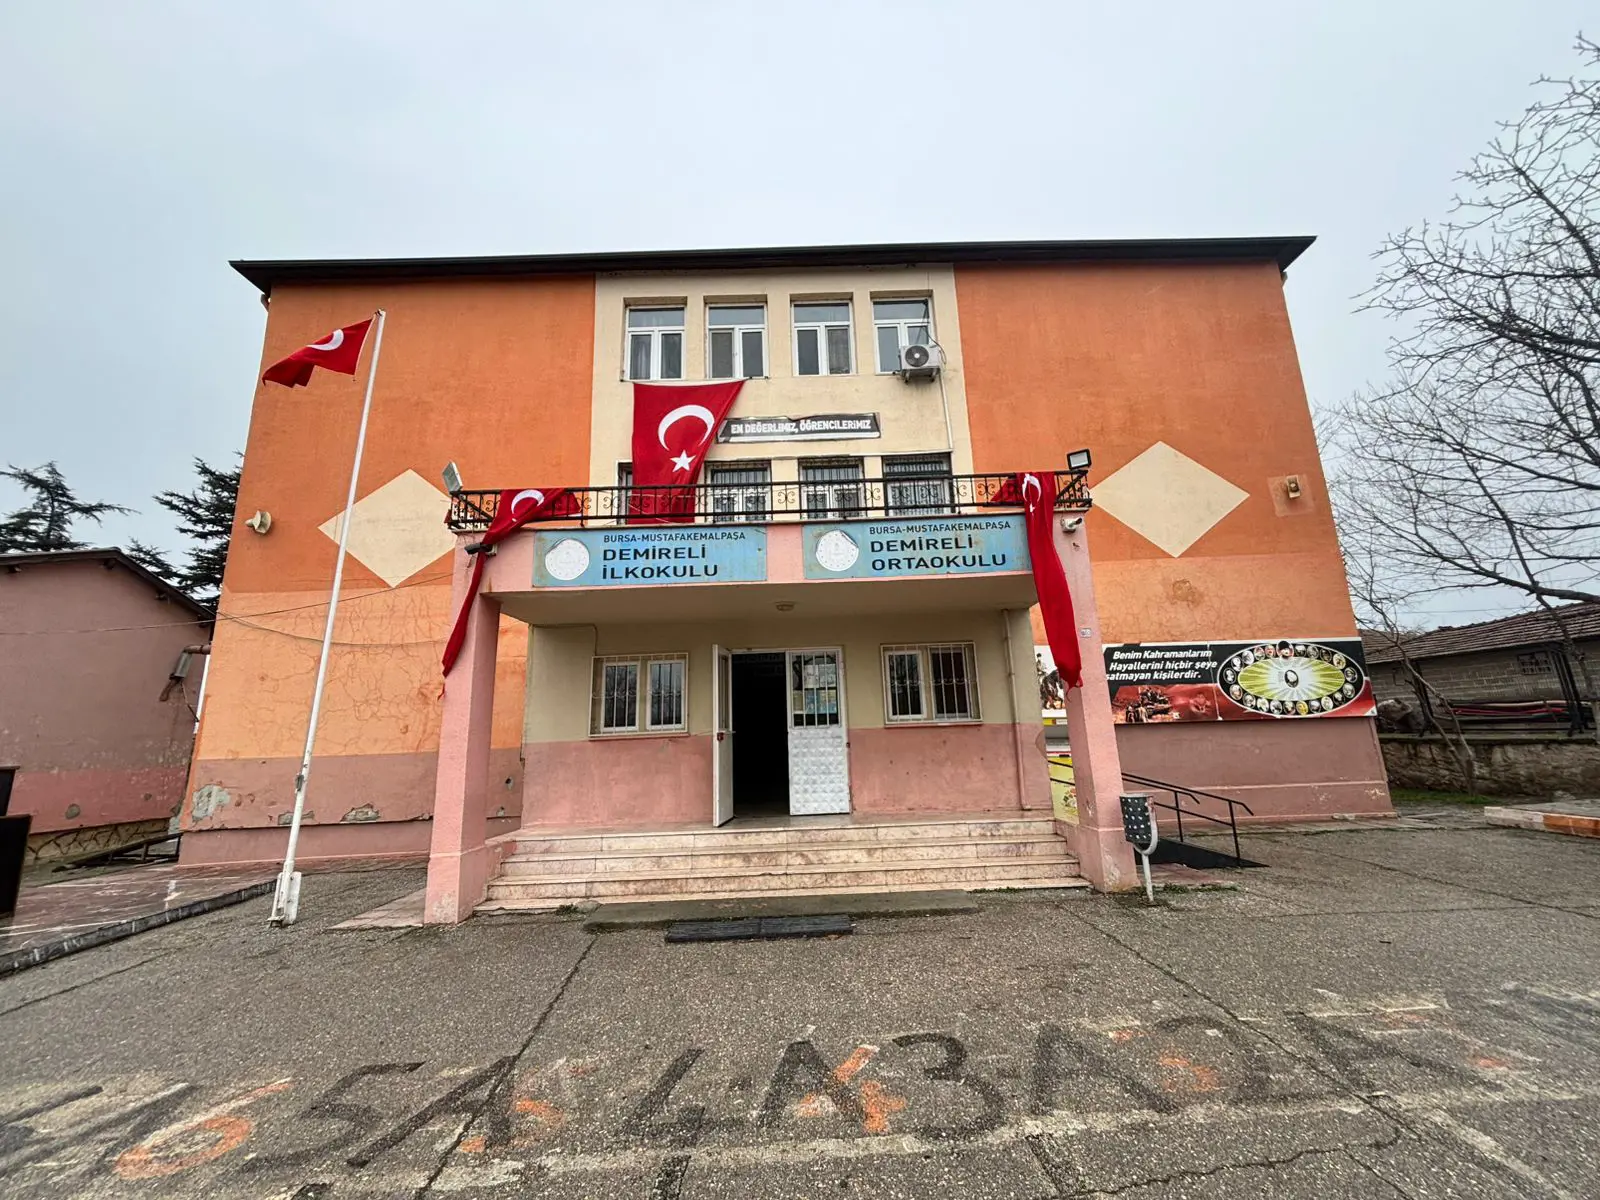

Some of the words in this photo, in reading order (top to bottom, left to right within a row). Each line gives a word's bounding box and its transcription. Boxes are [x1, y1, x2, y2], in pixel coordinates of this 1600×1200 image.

[731, 423, 744, 434] EN
[869, 520, 1012, 535] BURSA-MUSTAFAKEMALPAŞA
[603, 531, 746, 543] BURSA-MUSTAFAKEMALPAŞA
[870, 534, 973, 553] DEMİRELİ
[602, 544, 706, 561] DEMİRELİ
[871, 553, 1007, 571] ORTAOKULU
[602, 564, 718, 580] İLKOKULU
[1112, 650, 1142, 660] Benim
[1142, 649, 1213, 659] Kahramanlarım
[1109, 661, 1165, 672] Hayallerini
[1165, 660, 1193, 671] hiçbir
[1194, 660, 1218, 670] şeye
[1106, 673, 1152, 682] satmayan
[1152, 670, 1202, 680] kişilerdir.
